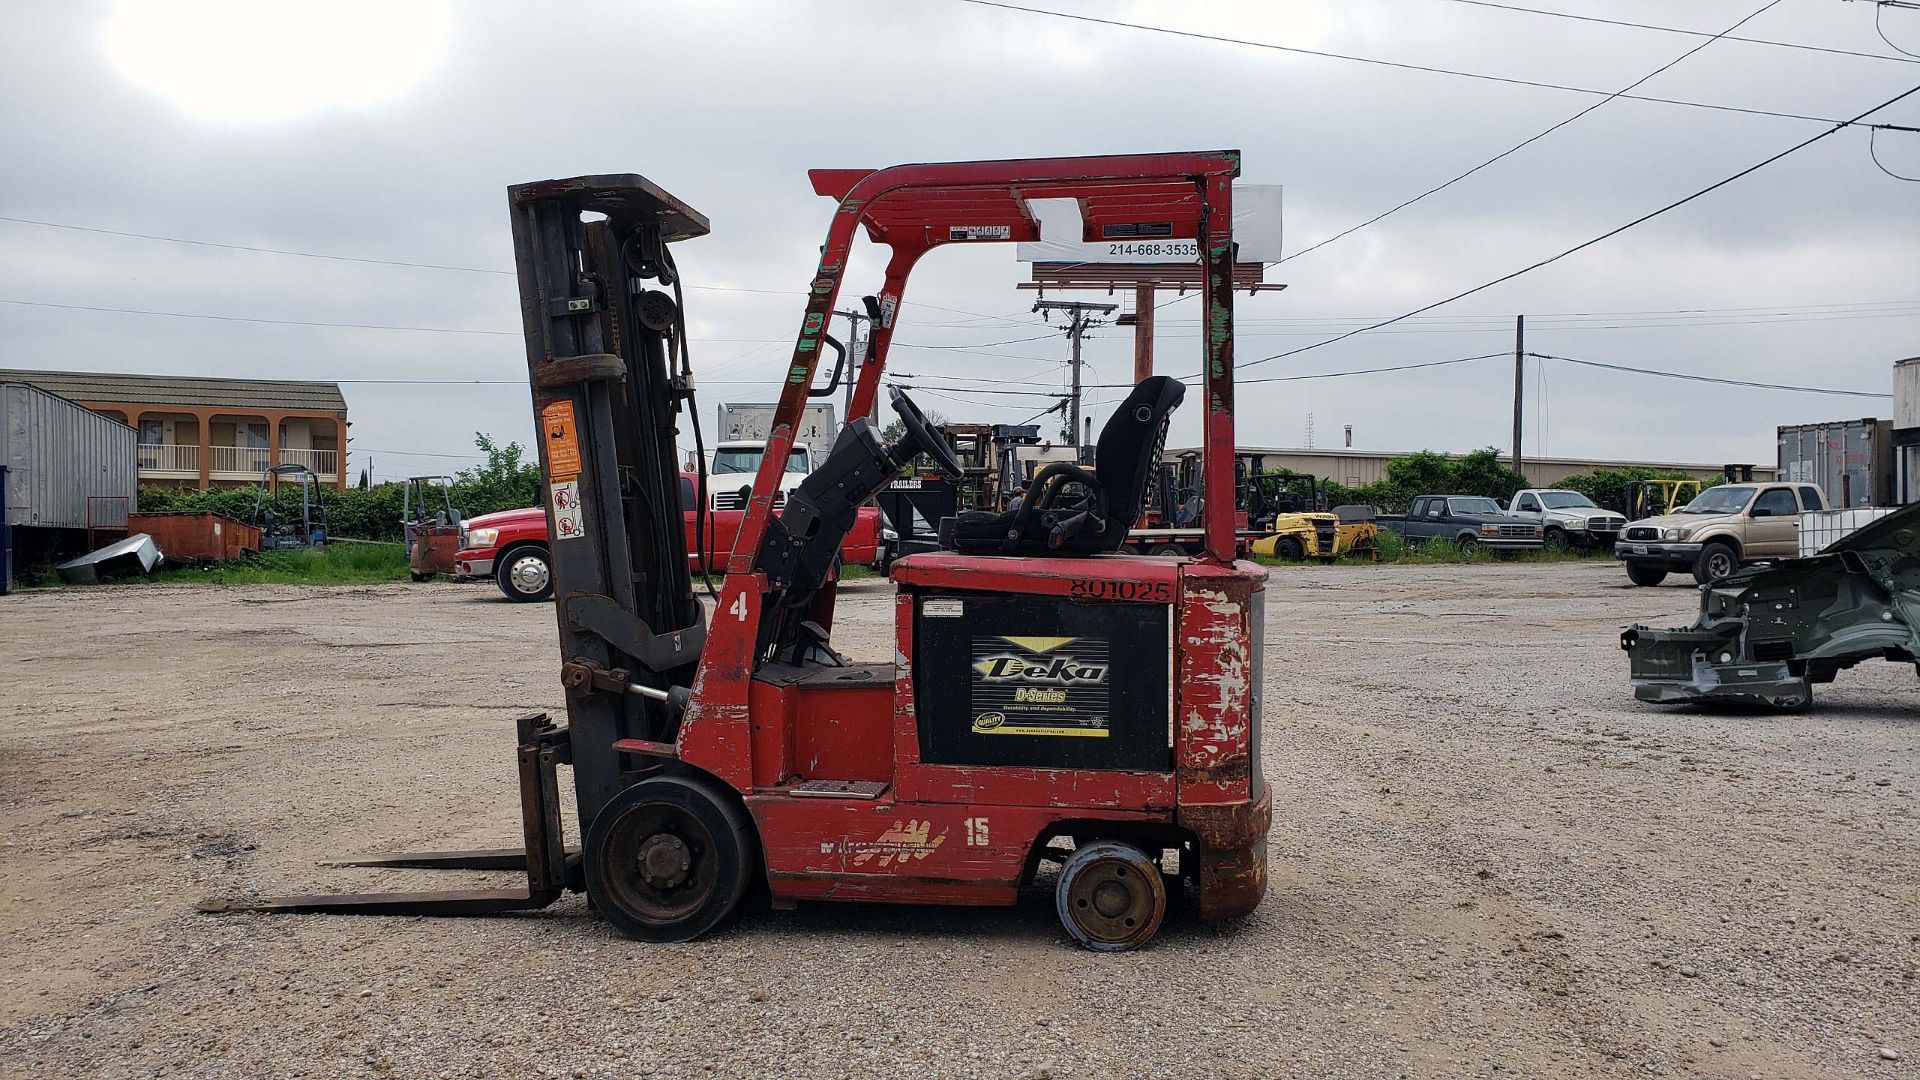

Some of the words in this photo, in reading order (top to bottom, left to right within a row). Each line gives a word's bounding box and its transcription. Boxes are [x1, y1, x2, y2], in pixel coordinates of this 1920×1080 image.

[1109, 244, 1197, 256] 214-668-3535
[1070, 580, 1170, 601] 801025
[730, 592, 748, 621] 4
[985, 657, 1105, 682] Deka
[1015, 688, 1066, 702] D-Series
[977, 715, 1002, 726] QUALITY
[964, 817, 989, 846] 15
